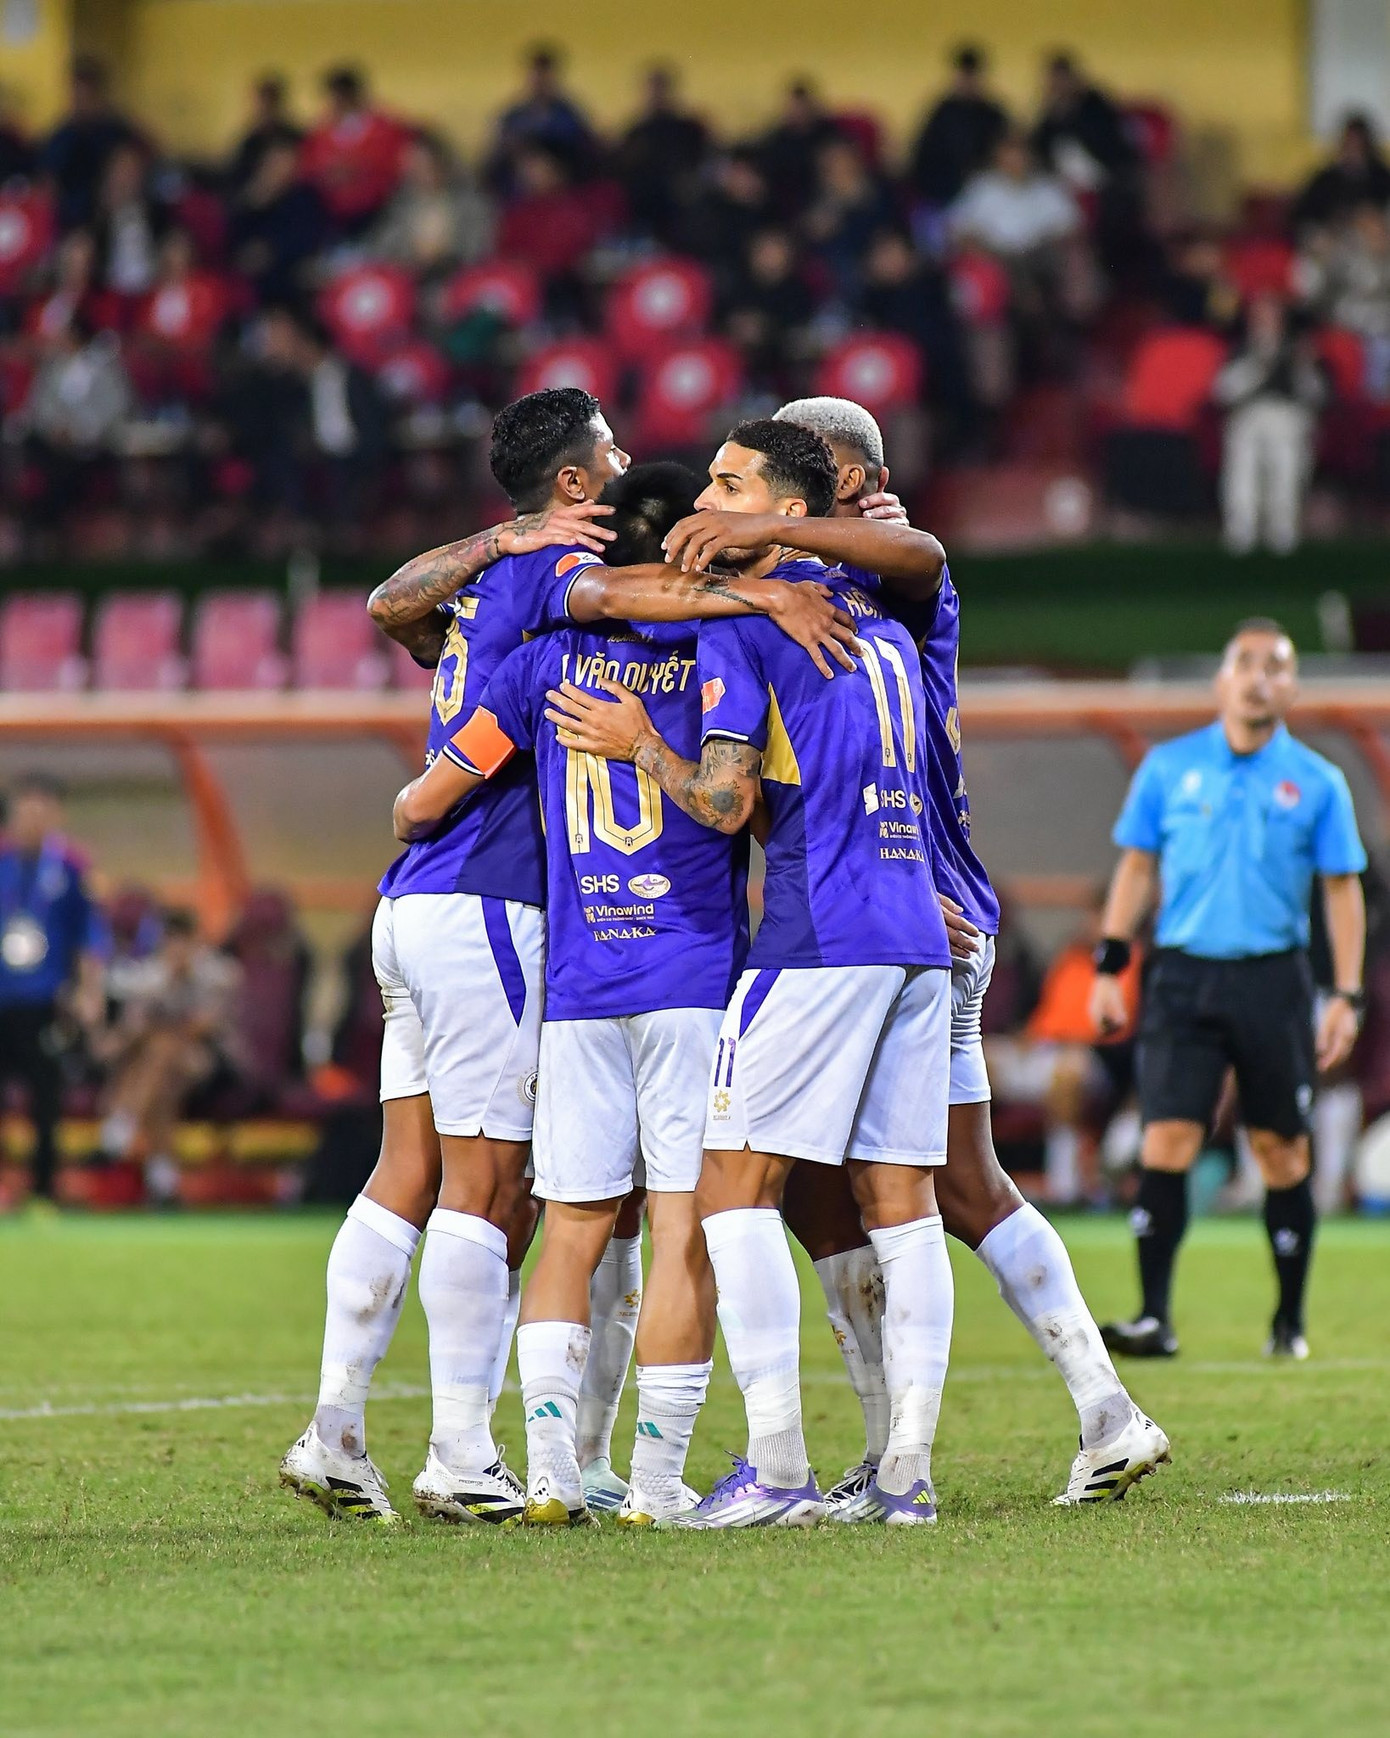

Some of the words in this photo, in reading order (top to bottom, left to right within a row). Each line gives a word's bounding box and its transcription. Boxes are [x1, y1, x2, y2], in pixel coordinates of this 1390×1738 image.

[851, 635, 917, 774] 11
[556, 725, 664, 857] 10
[580, 874, 620, 894] SHS
[595, 903, 654, 917] Vinawind
[714, 1037, 736, 1088] 11
